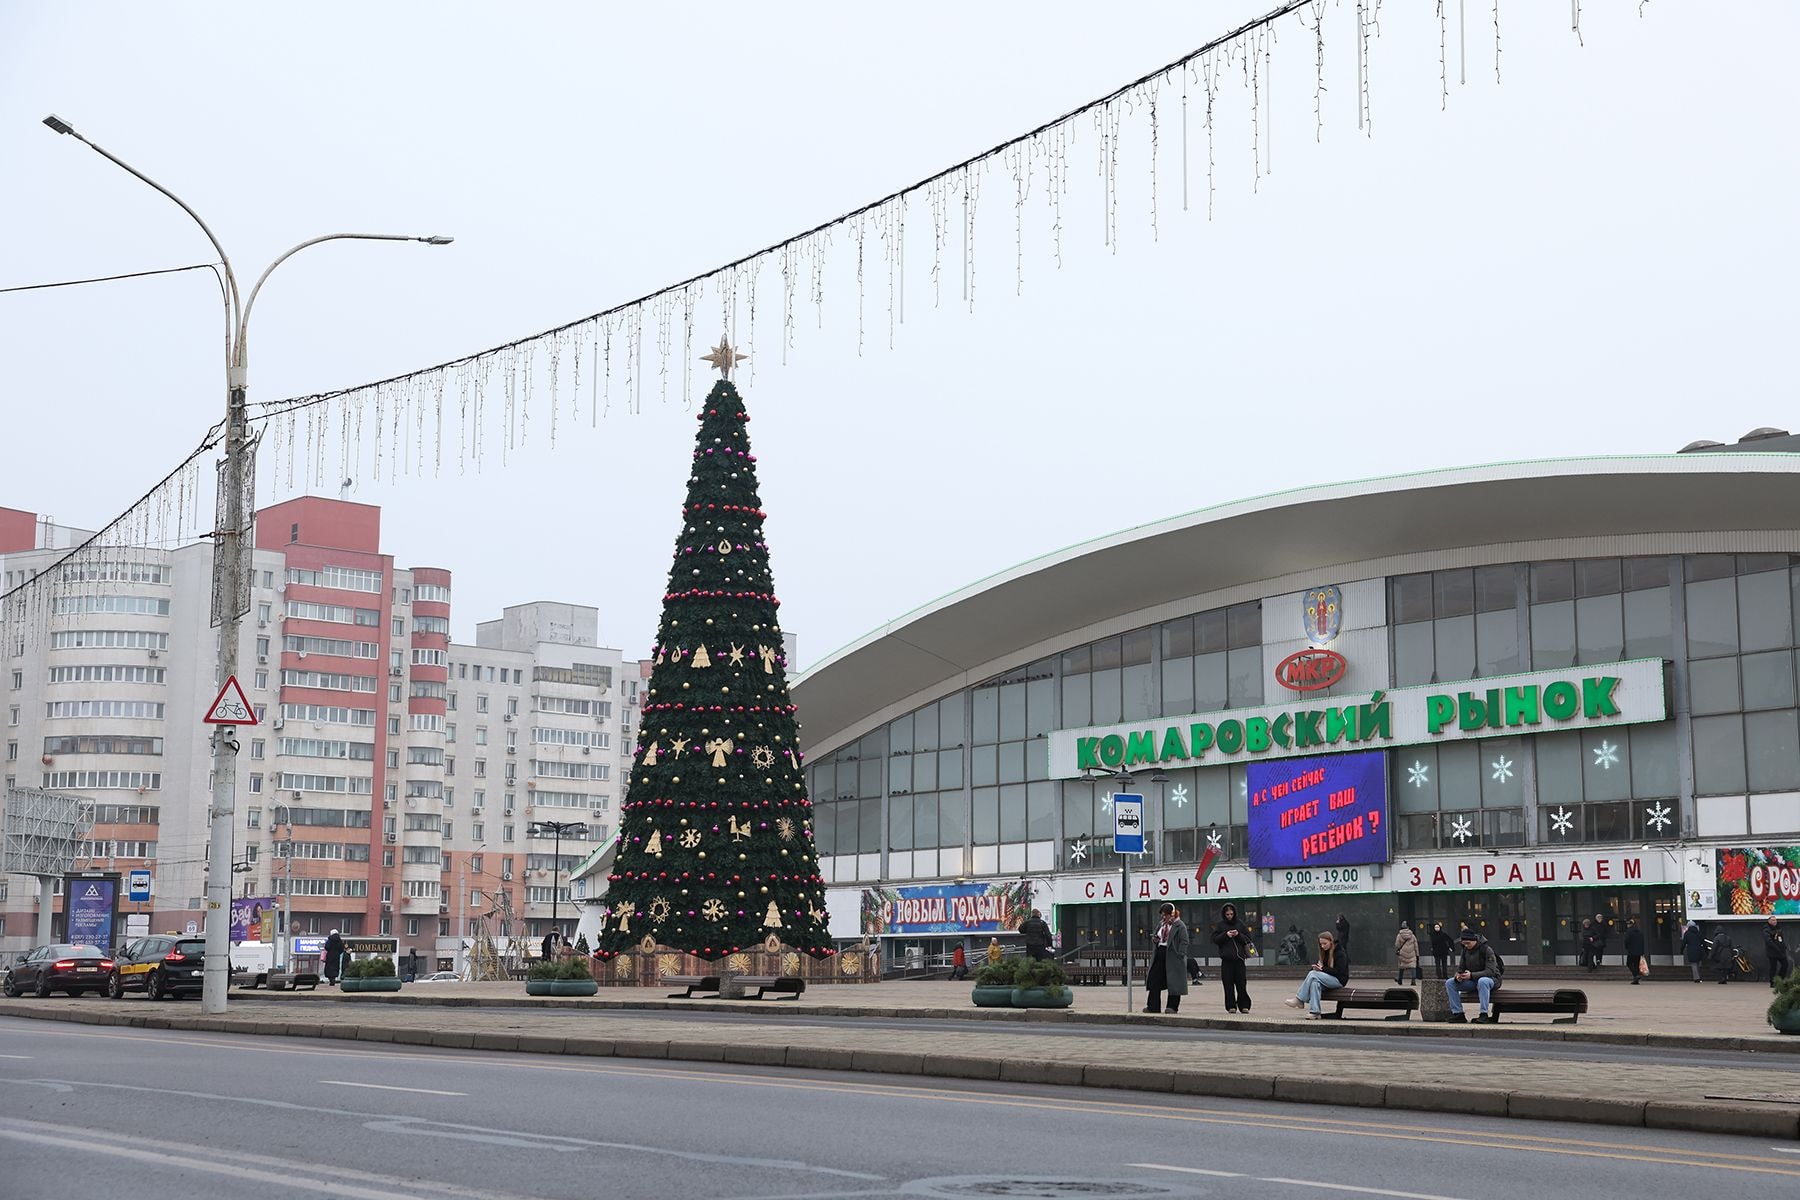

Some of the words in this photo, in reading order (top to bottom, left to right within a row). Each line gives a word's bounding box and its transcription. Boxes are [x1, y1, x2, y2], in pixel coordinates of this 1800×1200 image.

[1286, 657, 1335, 683] МКР
[1077, 690, 1394, 770] КОМАРОВСКИЙ
[1426, 676, 1622, 734] РЫНОК
[1253, 793, 1259, 806] А
[1262, 789, 1267, 802] С
[1291, 768, 1325, 792] СЕЙЧАС
[1281, 800, 1319, 829] ИГРАЕТ
[1329, 787, 1355, 811] ВАШ
[1302, 815, 1364, 860] РЕБЁНОК
[1286, 871, 1312, 885] 9.00
[1324, 868, 1358, 883] 19.00
[1409, 858, 1642, 887] ЗАПРАШАЕМ
[1751, 866, 1763, 896] С
[1085, 876, 1230, 899] САДЭЧНА
[1286, 884, 1316, 893] ВЫХОДНОЙ
[1320, 883, 1359, 892] ПОНЕДЕЛЬНИК
[883, 900, 892, 924] С
[896, 898, 946, 923] НОВЫМ
[951, 895, 1008, 928] ГОДОМ!
[353, 943, 392, 952] ЛОМБАРД
